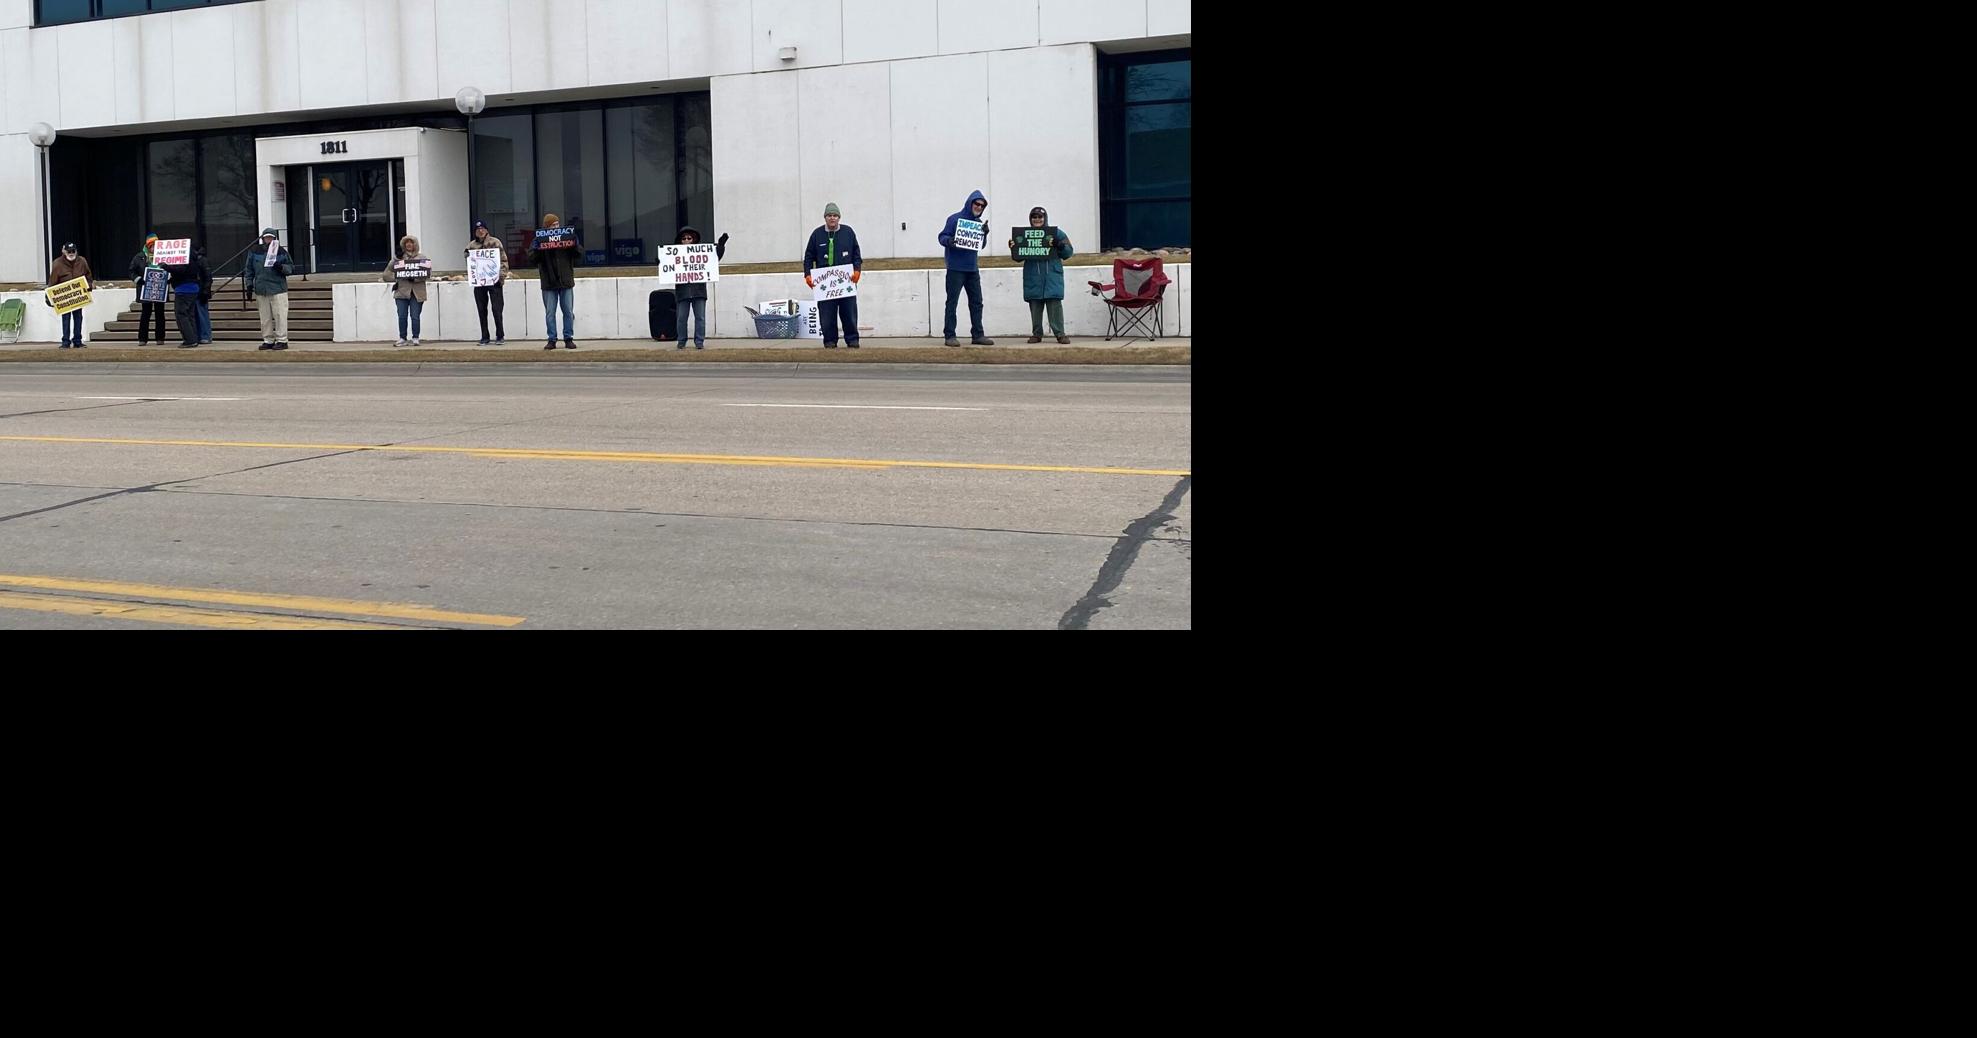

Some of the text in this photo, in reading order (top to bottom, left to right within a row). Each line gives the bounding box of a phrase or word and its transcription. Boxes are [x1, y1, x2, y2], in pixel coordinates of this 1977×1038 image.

[320, 140, 348, 154] 1811
[957, 219, 984, 231] IMPEAC
[535, 227, 575, 237] DEMOCRACY
[956, 229, 985, 241] CONVICT
[1024, 229, 1046, 238] FEED
[156, 240, 188, 249] RAGE
[539, 239, 576, 249] ESTRUCTION
[955, 238, 980, 249] REMOVE
[1027, 239, 1043, 247] THE
[614, 244, 640, 257] vigo
[665, 244, 714, 256] SO MUCH
[1018, 247, 1051, 256] HUNGRY
[154, 255, 188, 264] REGIME
[675, 254, 709, 264] BLOOD
[404, 262, 420, 270] FIRE
[662, 264, 675, 273] ON
[396, 270, 428, 278] HEGSETH
[829, 280, 837, 288] IS
[825, 288, 845, 298] FREE
[808, 306, 818, 335] BEING
